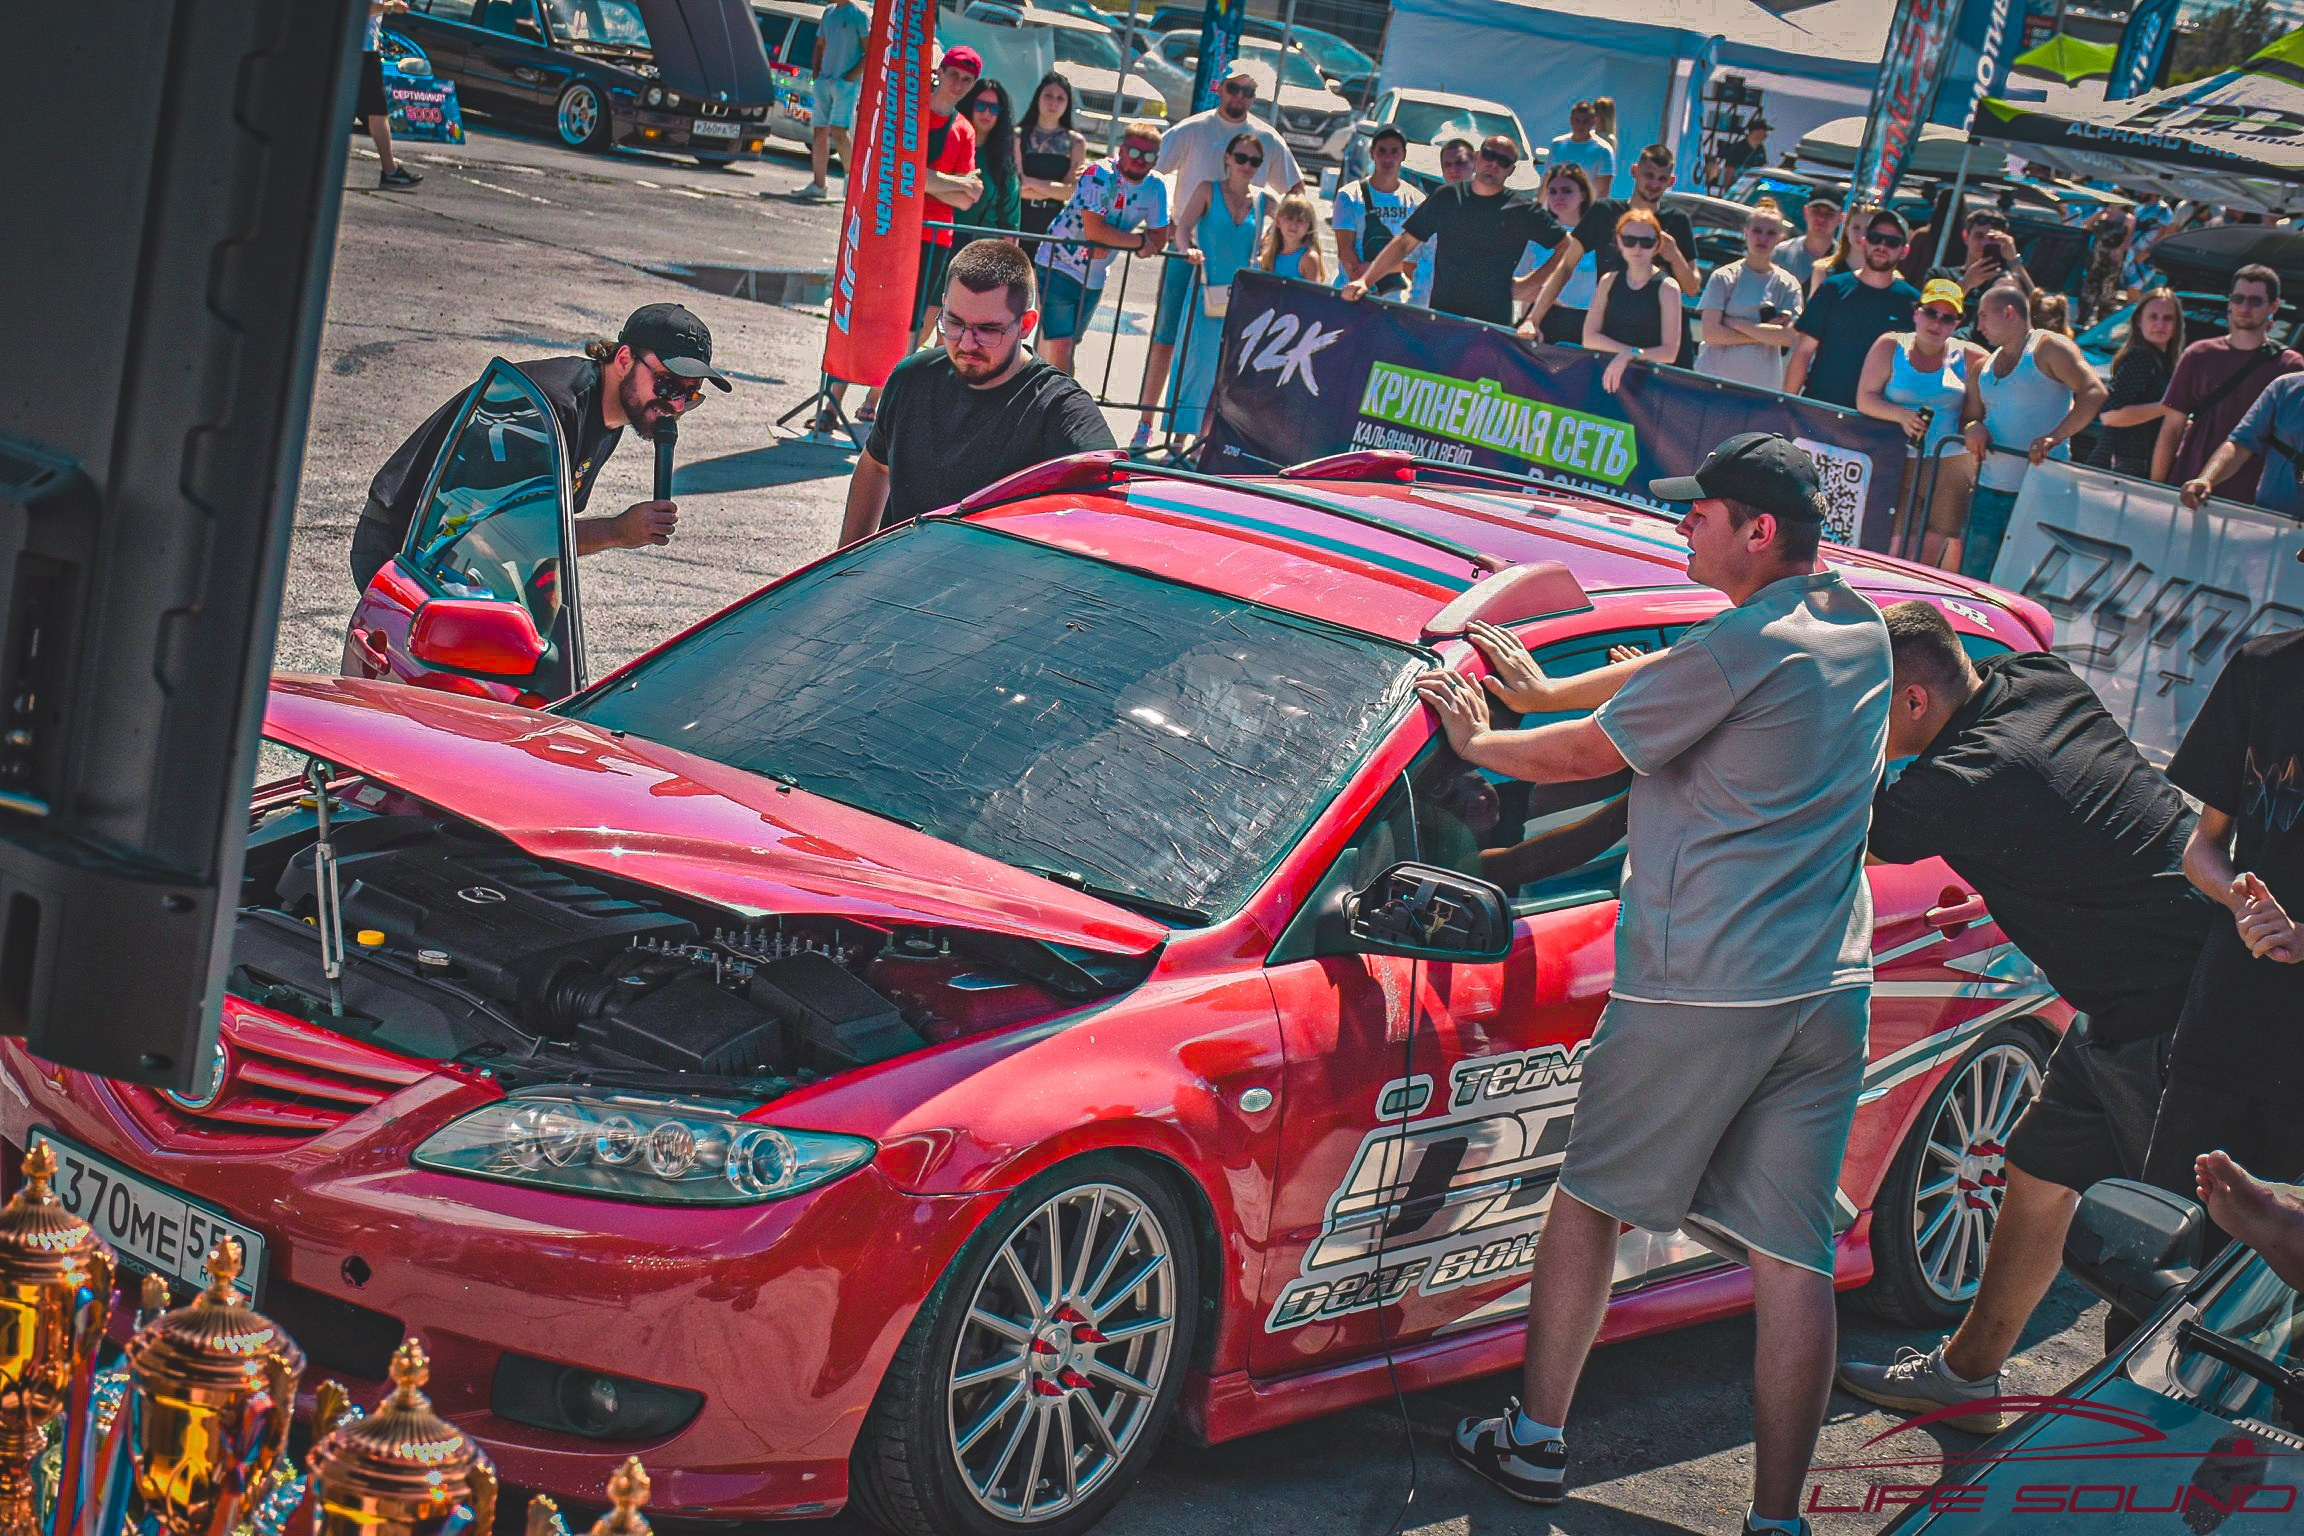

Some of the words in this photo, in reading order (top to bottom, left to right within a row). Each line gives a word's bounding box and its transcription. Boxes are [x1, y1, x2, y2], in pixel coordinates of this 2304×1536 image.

[405, 104, 442, 123] 5000
[834, 205, 862, 335] LIFE
[1237, 307, 1345, 397] 12K
[1352, 421, 1430, 457] КАЛЬЯННЫХ
[1362, 368, 1553, 457] КРУПНЕЙШАЯ
[1552, 416, 1629, 477] СЕТЬ
[1544, 1441, 1565, 1455] NIKE
